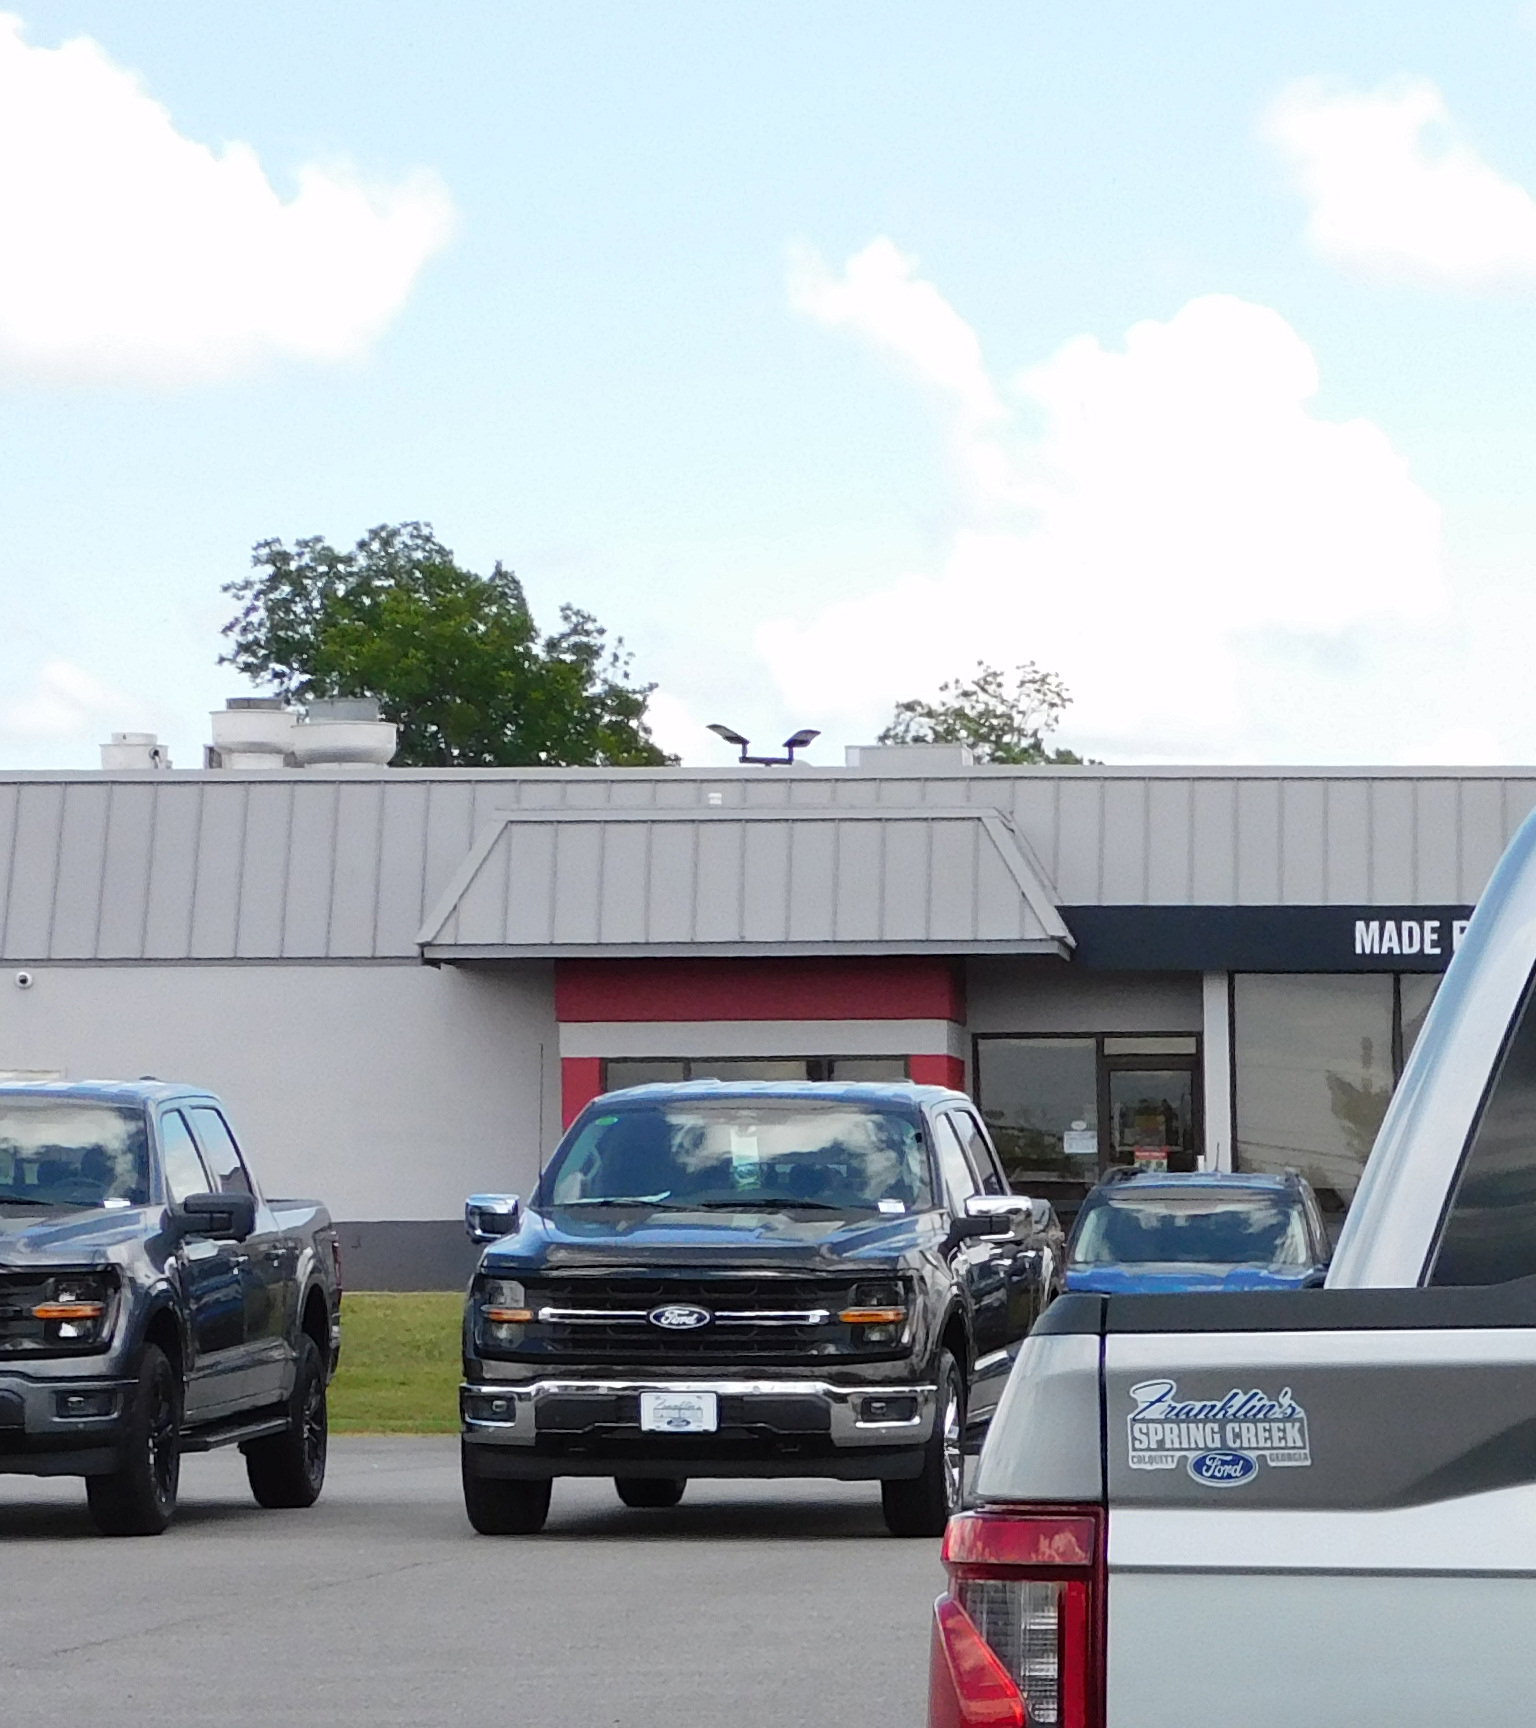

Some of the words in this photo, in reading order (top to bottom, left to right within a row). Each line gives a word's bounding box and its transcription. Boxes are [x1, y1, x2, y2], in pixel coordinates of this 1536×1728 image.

[1355, 920, 1442, 954] MADE
[660, 1309, 700, 1325] Ford
[1131, 1381, 1299, 1422] Franklin's
[1133, 1422, 1221, 1449] SPRING
[1226, 1421, 1304, 1448] CREEK
[1130, 1453, 1176, 1465] COLQUITT
[1202, 1453, 1244, 1478] Ford
[1268, 1452, 1309, 1463] GEORGIA
